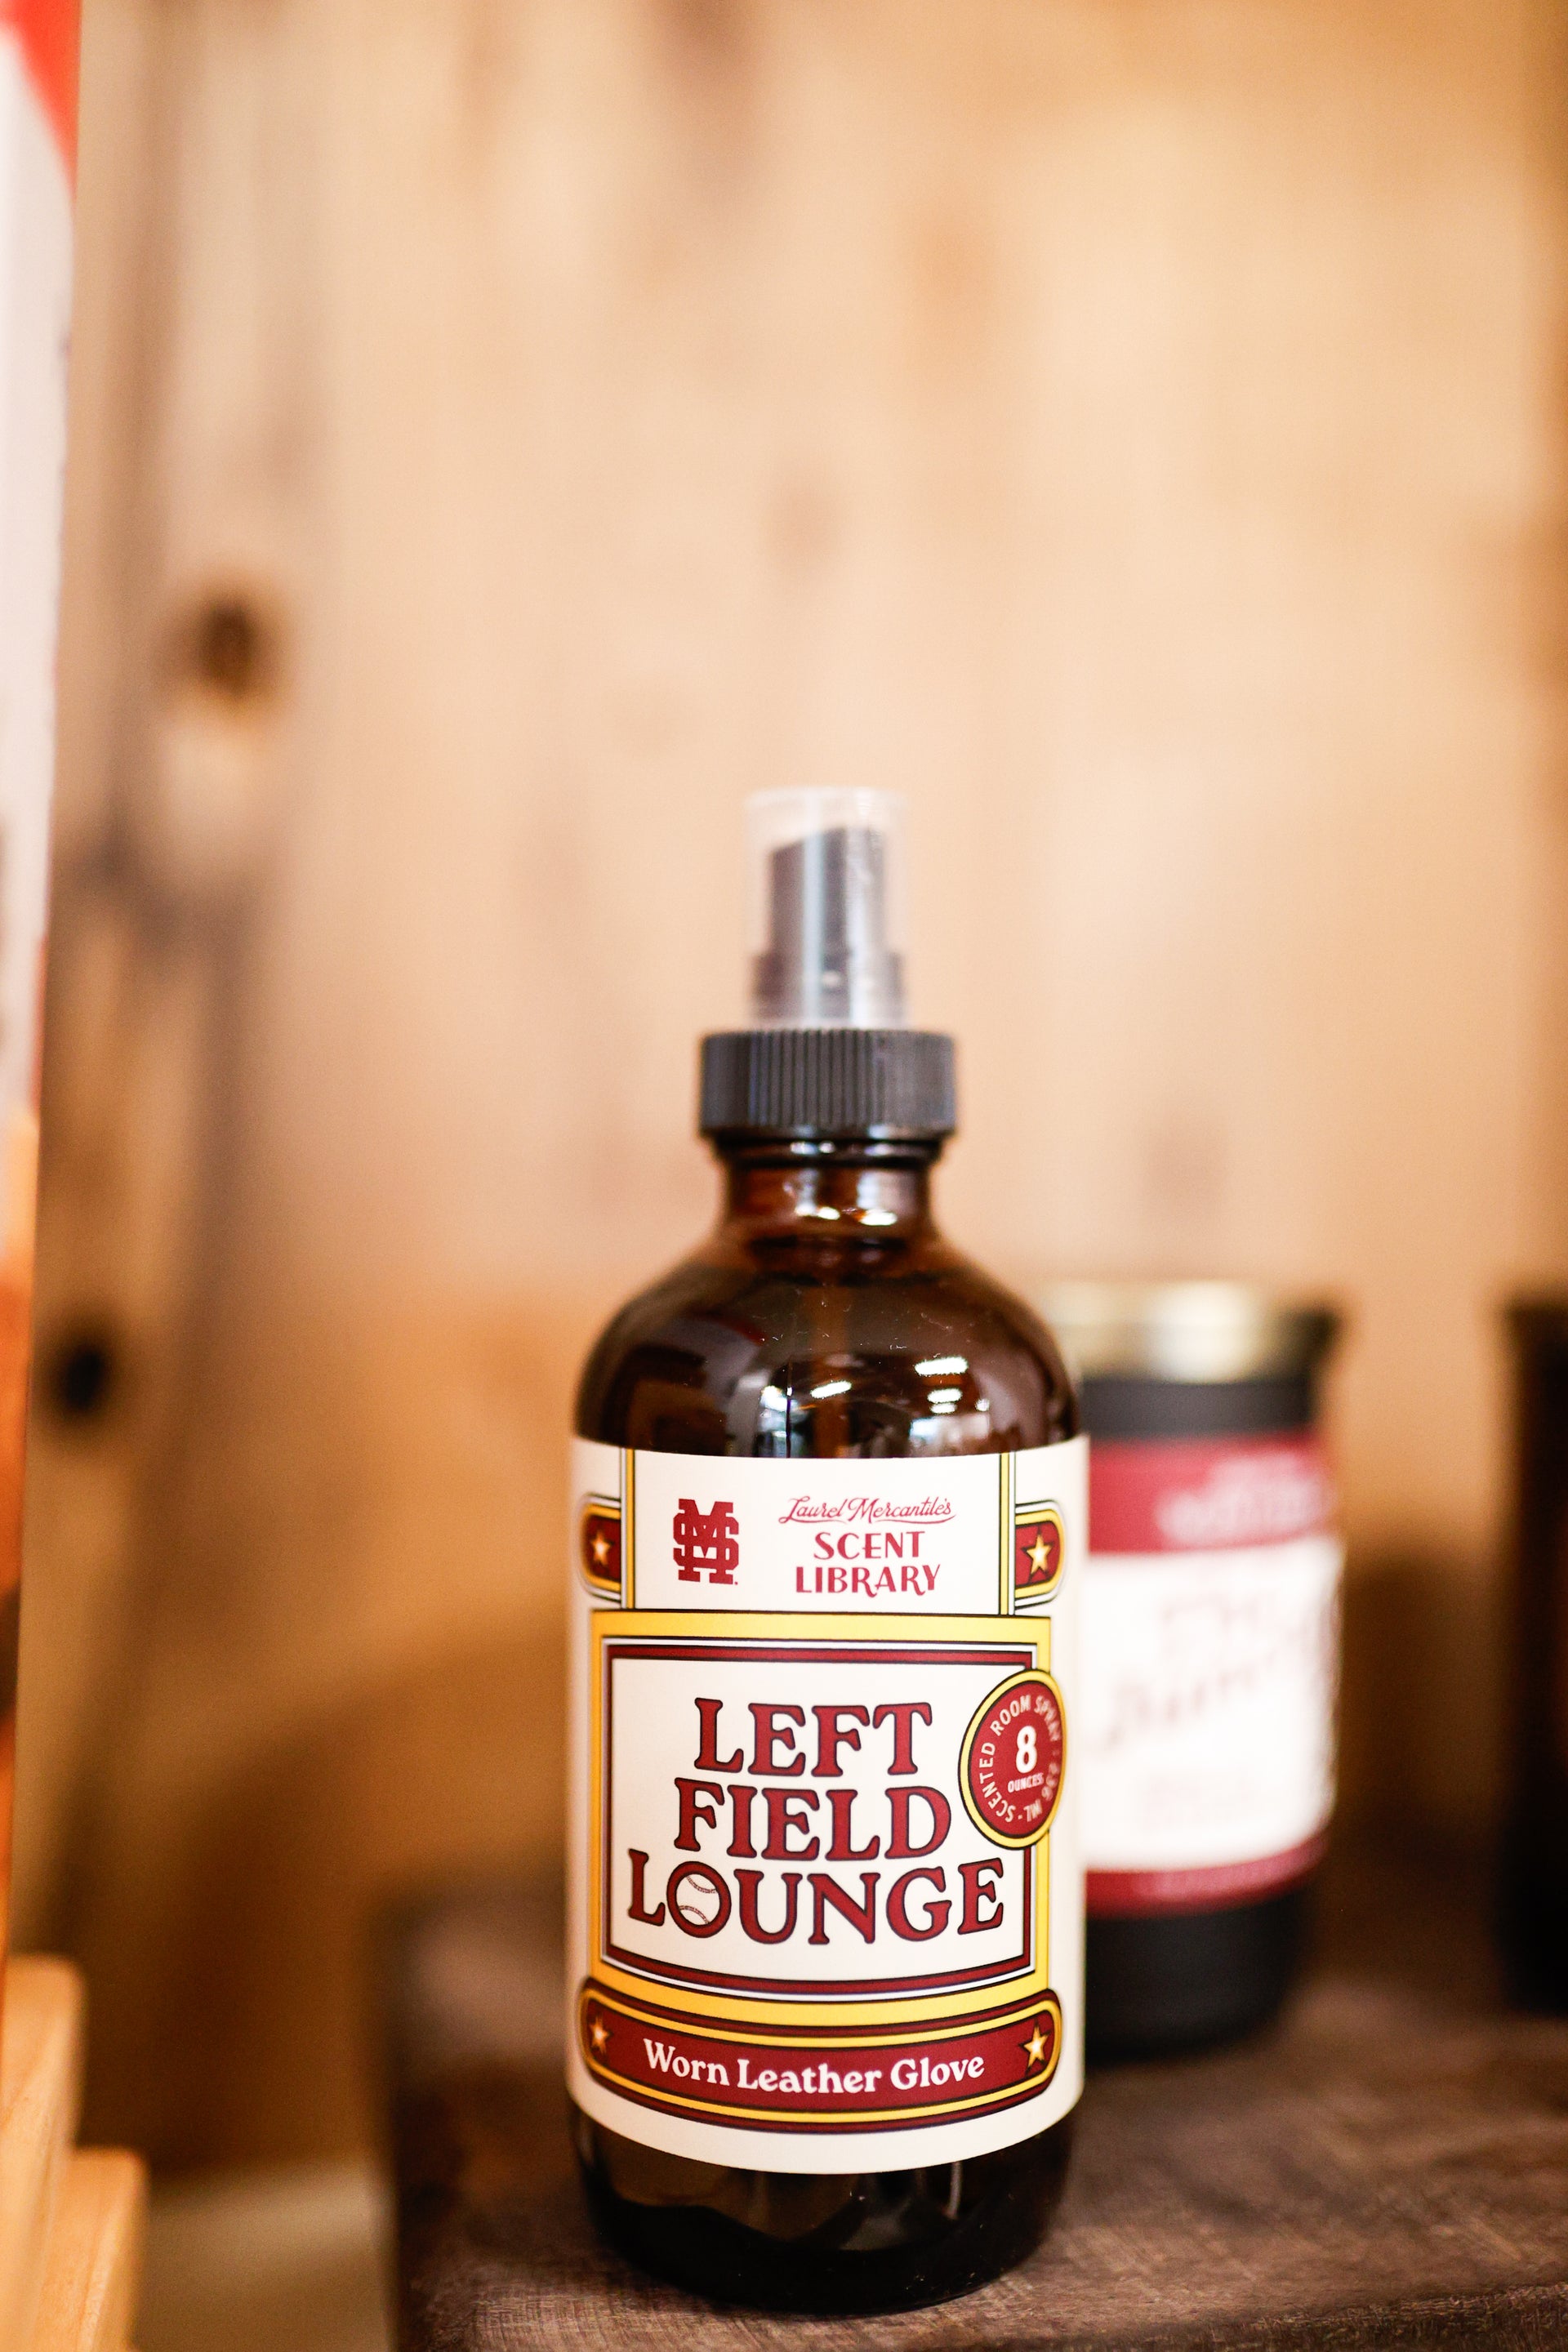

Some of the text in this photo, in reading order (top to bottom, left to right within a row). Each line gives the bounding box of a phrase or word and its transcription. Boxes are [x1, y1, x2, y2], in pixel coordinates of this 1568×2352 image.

[778, 1495, 957, 1525] Laurel Mercantile's
[813, 1530, 926, 1560] SCENT
[795, 1564, 942, 1598] LIBRARY
[693, 1697, 933, 1778] LEFT
[990, 1694, 1031, 1737] ROOM
[1014, 1724, 1038, 1774] 8
[978, 1741, 1017, 1823] SCENTED
[1007, 1771, 1045, 1793] OUNCES
[674, 1776, 952, 1862] FIELD
[627, 1847, 1005, 1946] LOUNGE
[643, 2038, 986, 2094] Worn Leather Glove
